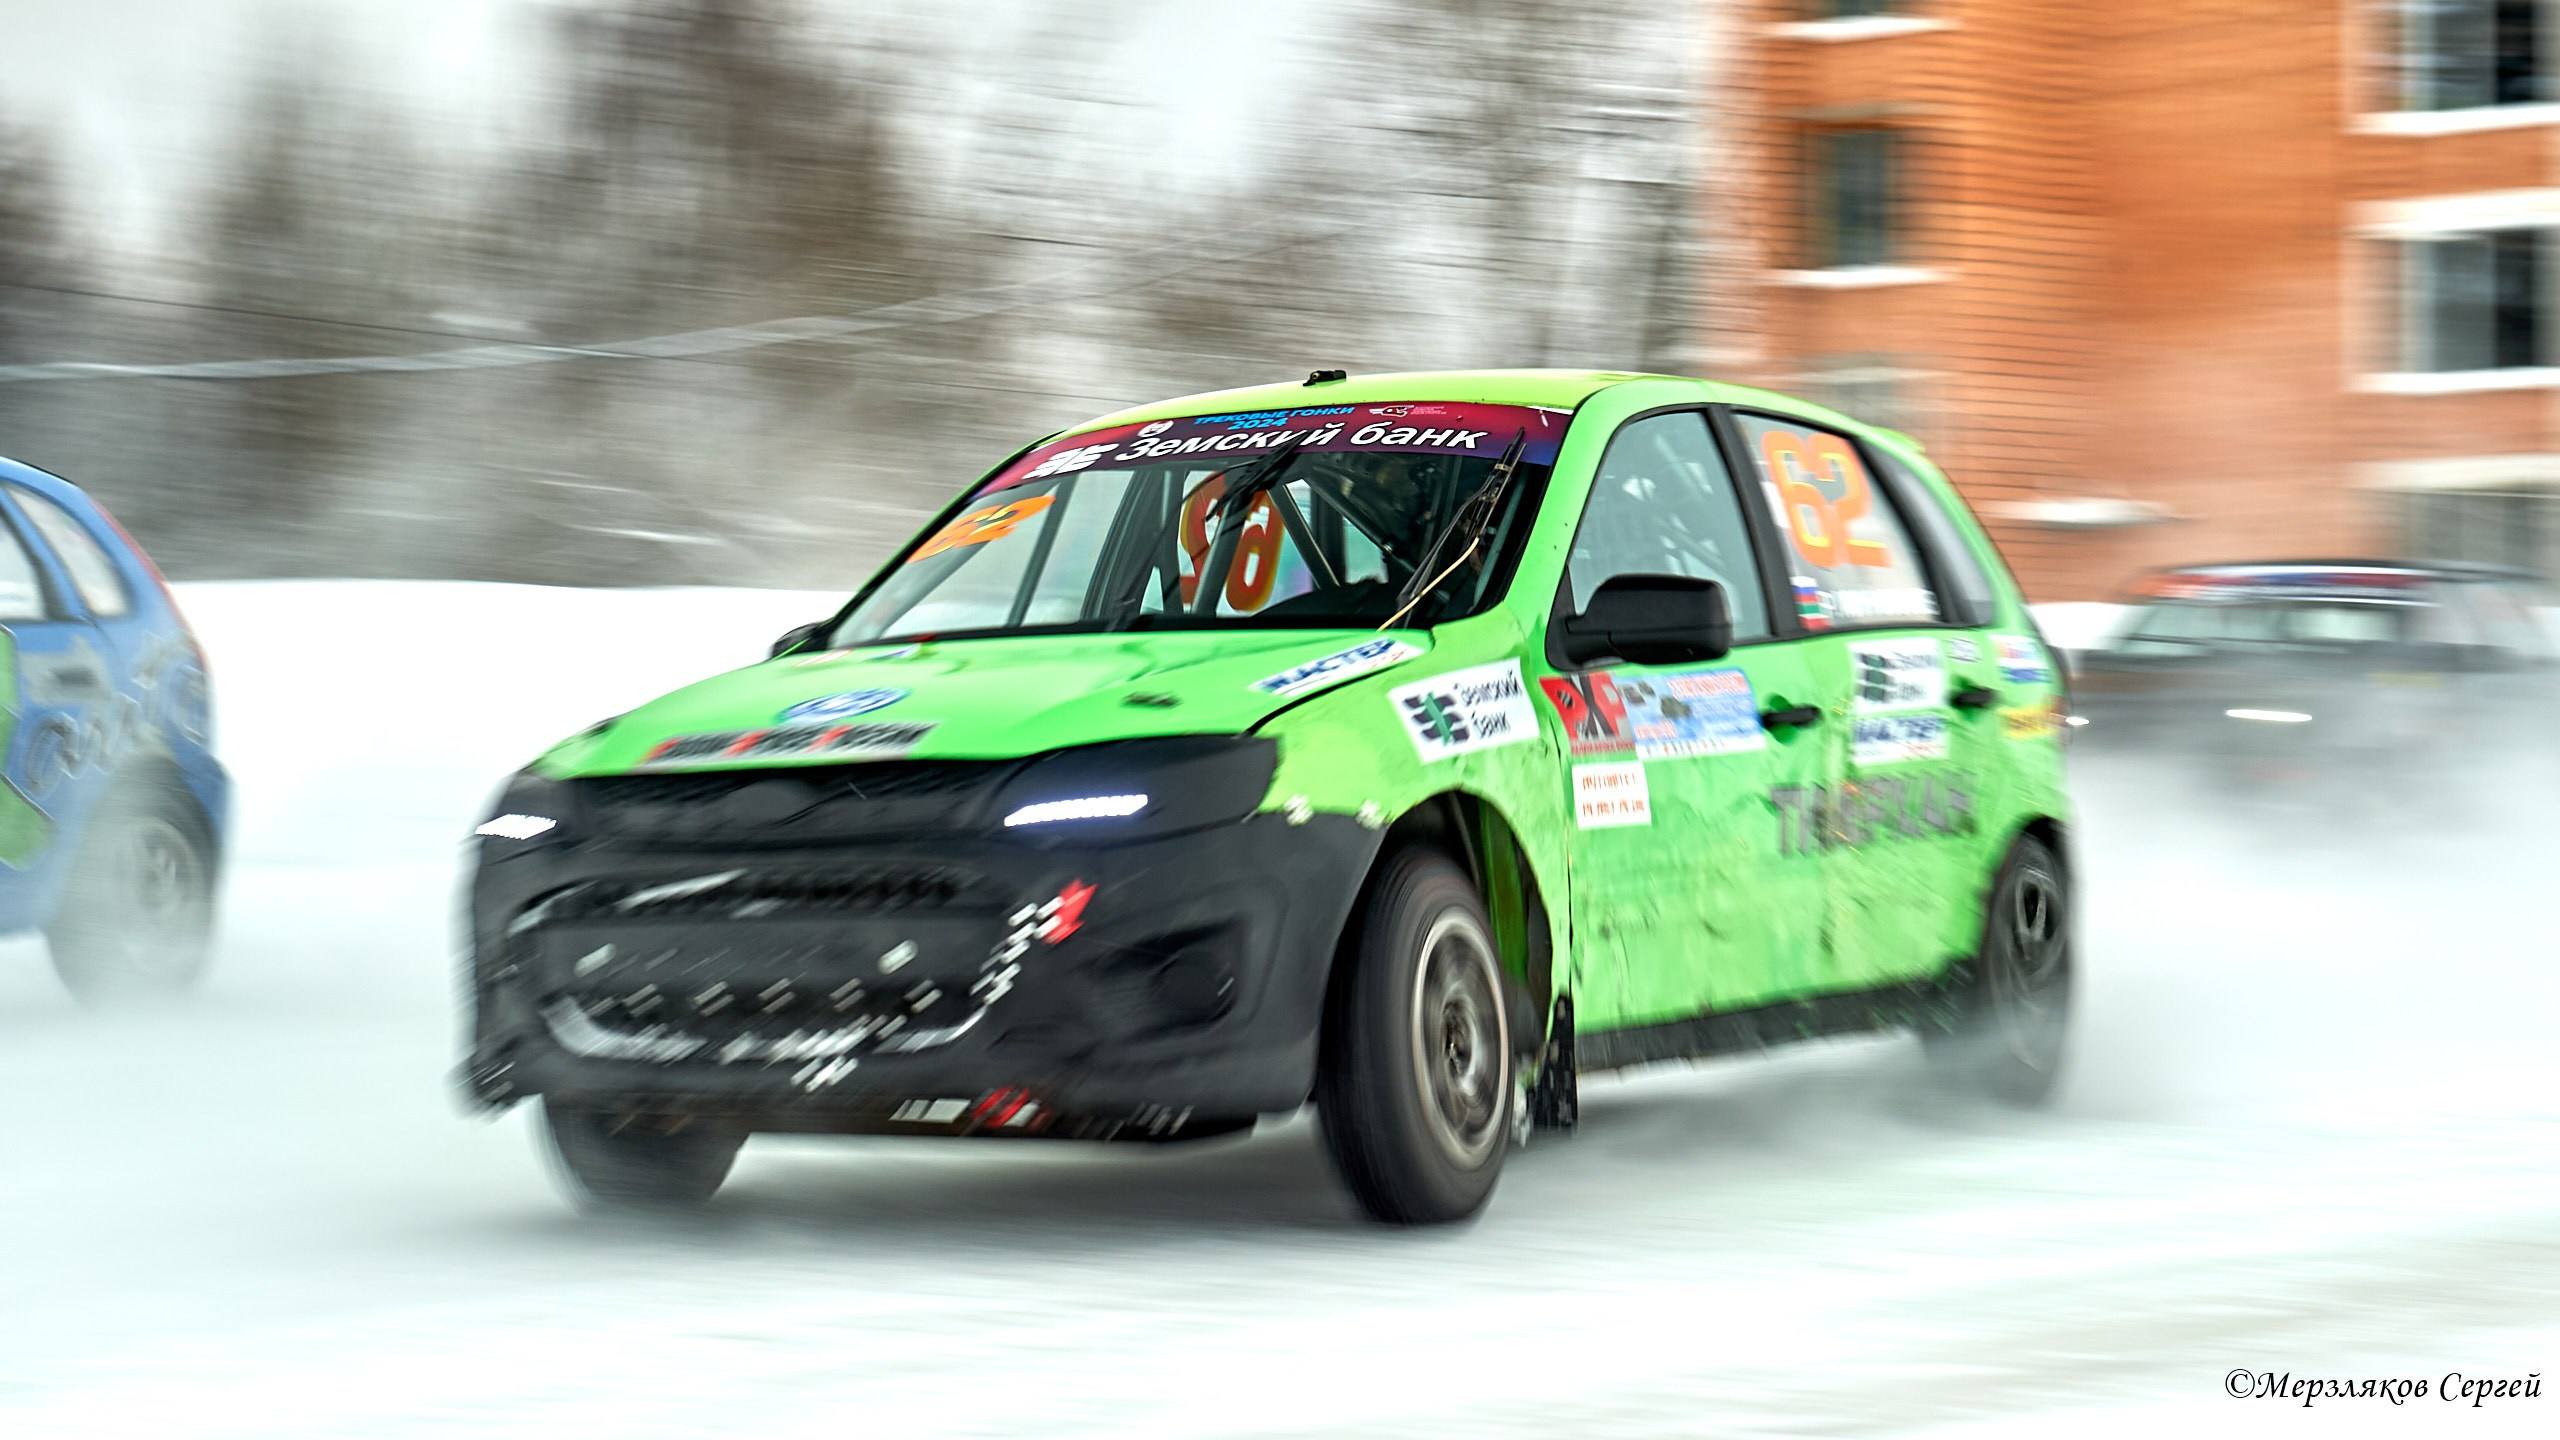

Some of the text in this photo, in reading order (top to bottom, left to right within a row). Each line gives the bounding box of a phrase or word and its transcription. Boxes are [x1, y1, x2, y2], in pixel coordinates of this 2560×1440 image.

[1194, 407, 1354, 425] ТРЕКОВЫЕ ГОНКИ
[1227, 417, 1288, 430] 2024
[1115, 421, 1488, 461] Земский банк
[1760, 430, 1895, 568] 62
[906, 495, 1056, 563] 62
[1453, 668, 1523, 707] Земский
[1471, 711, 1511, 738] банк
